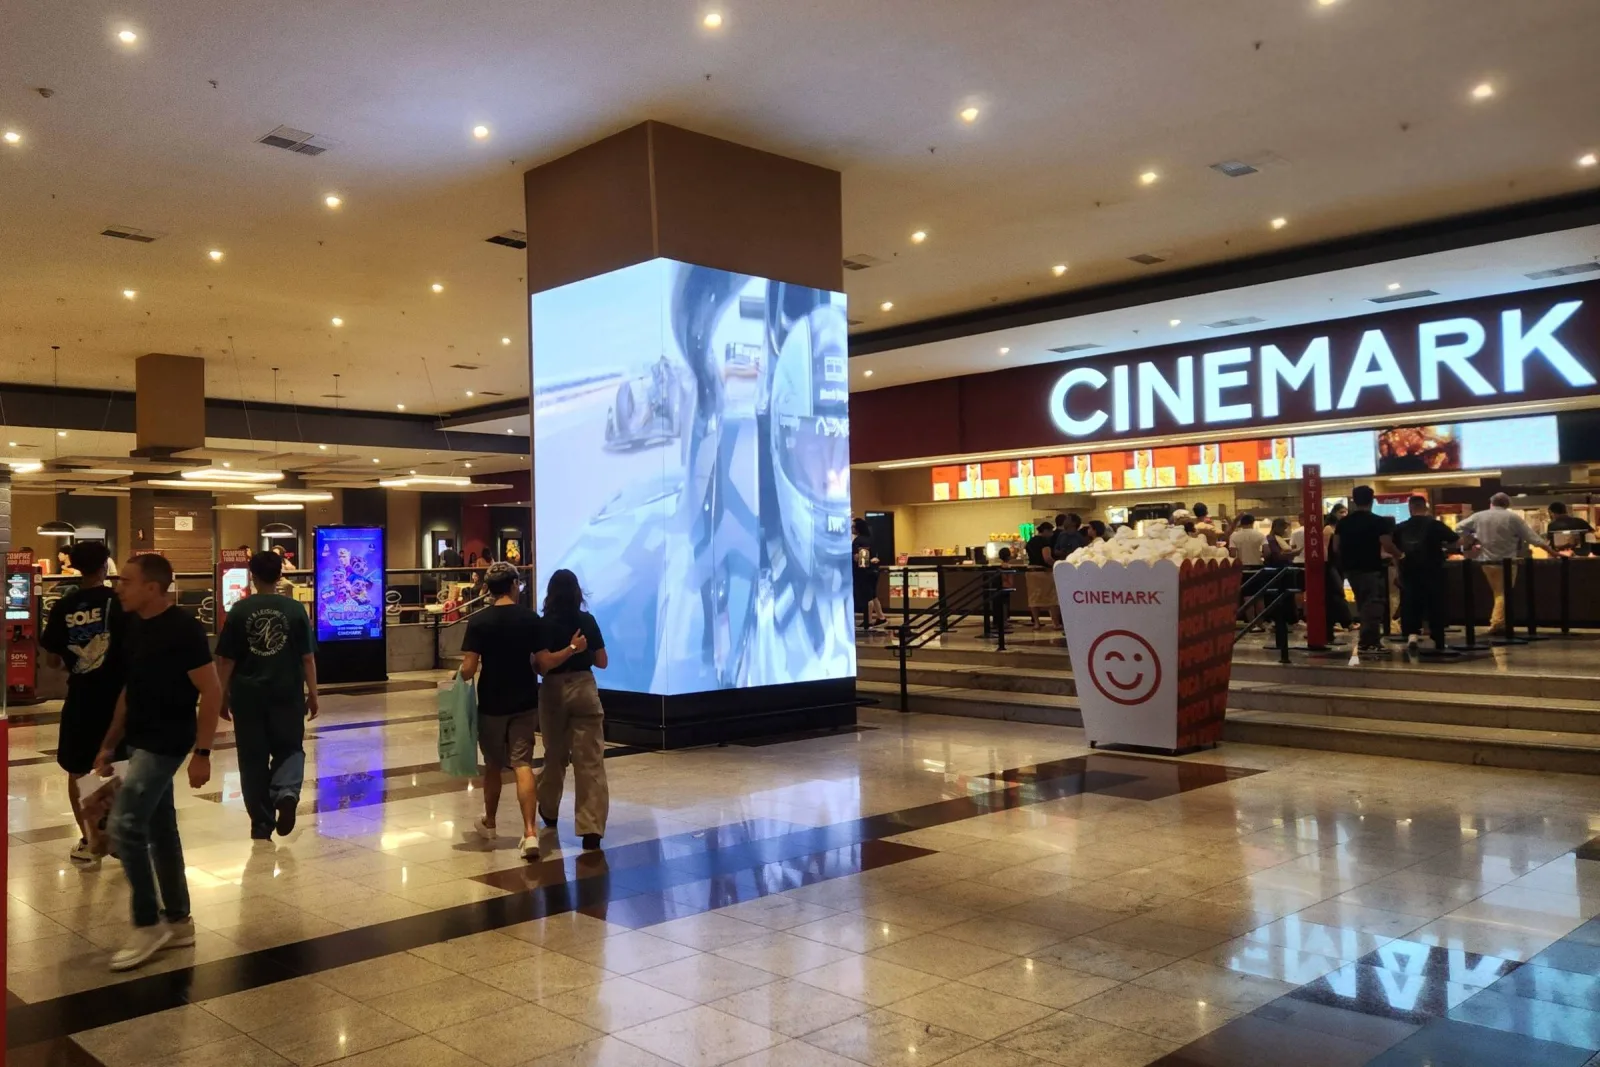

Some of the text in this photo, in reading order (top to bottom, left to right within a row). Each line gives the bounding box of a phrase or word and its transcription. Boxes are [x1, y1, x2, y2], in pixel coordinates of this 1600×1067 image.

[1049, 299, 1598, 437] CINEMARK
[1308, 467, 1319, 559] RETIRADA
[65, 607, 102, 628] SOLE
[1072, 590, 1162, 605] CINEMARK
